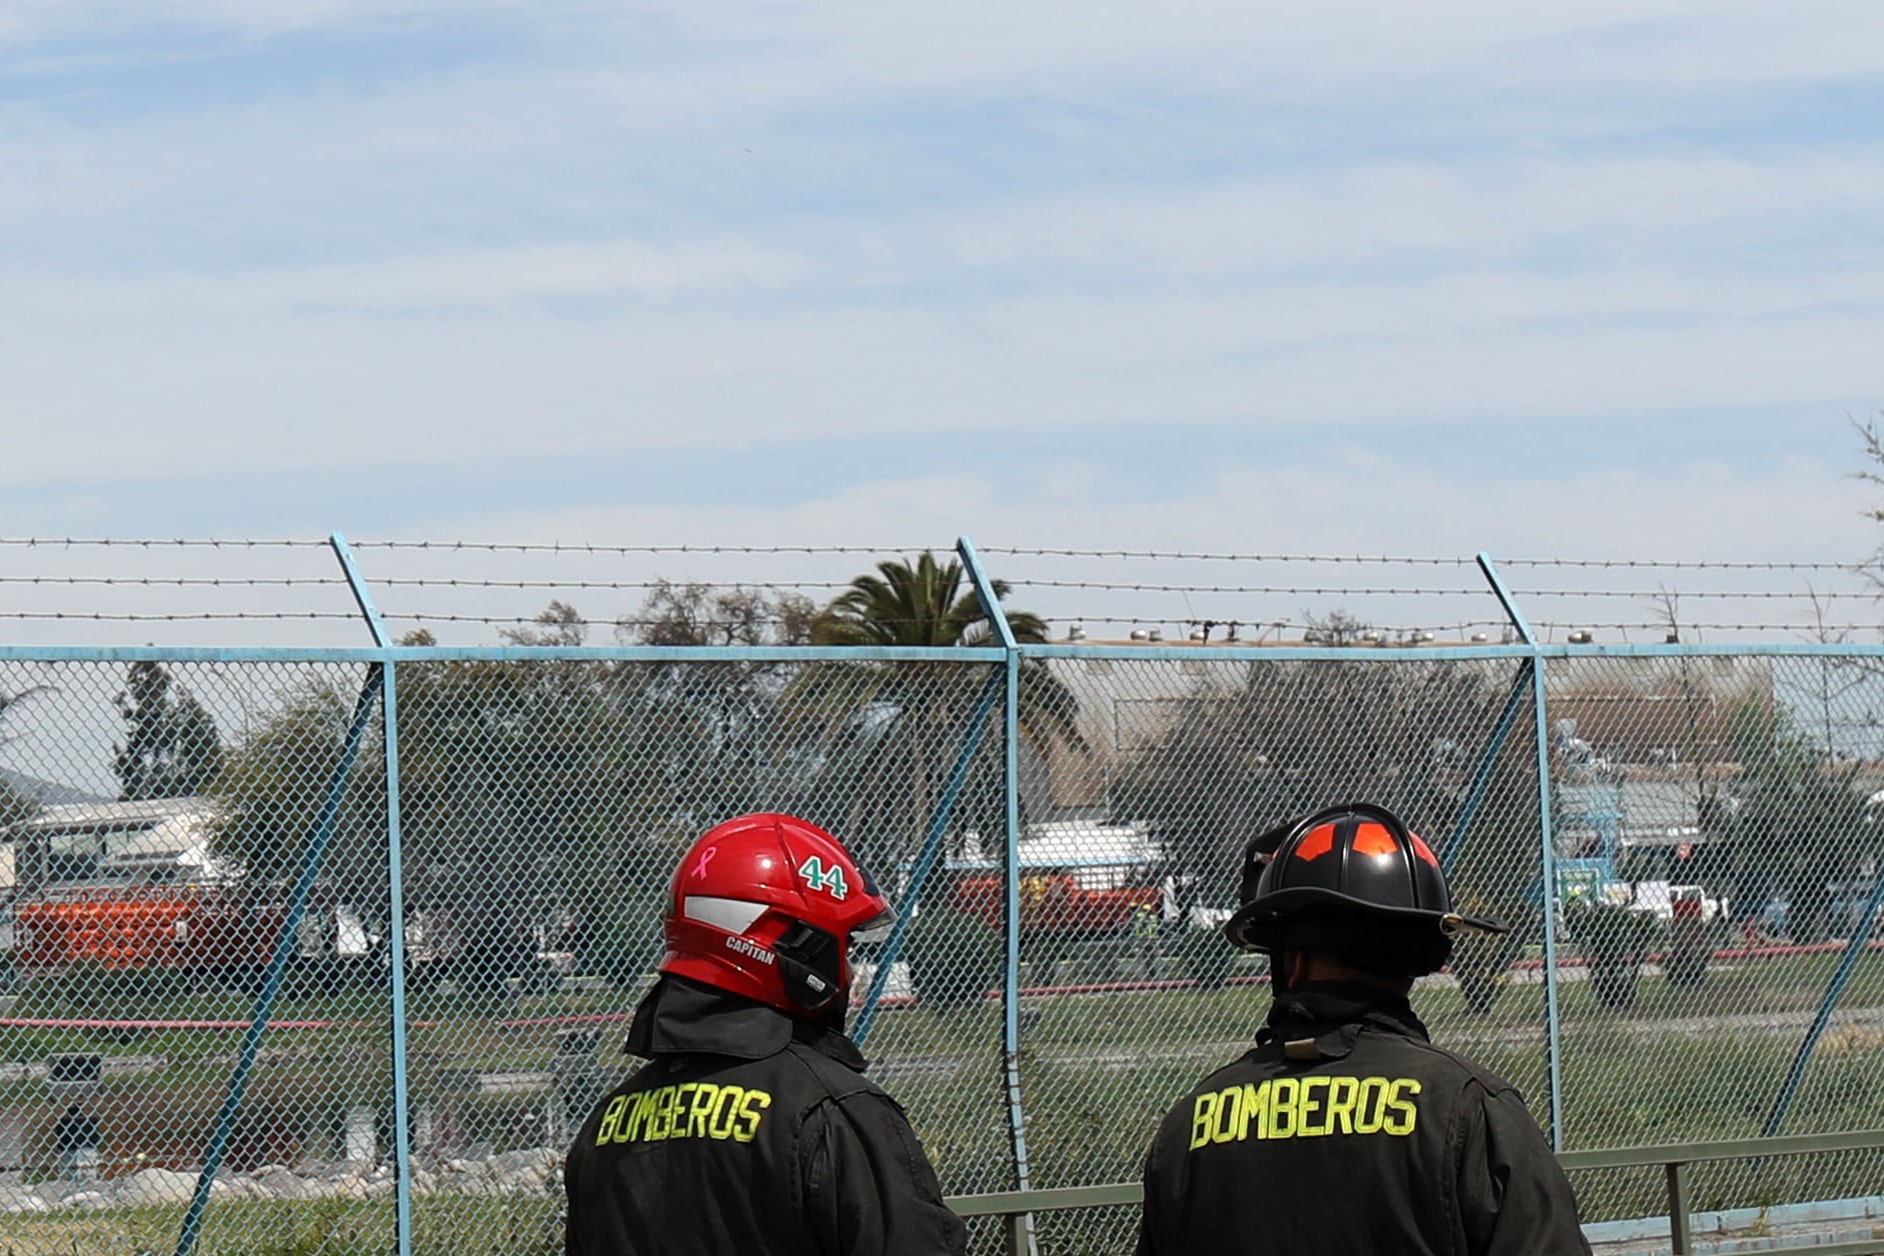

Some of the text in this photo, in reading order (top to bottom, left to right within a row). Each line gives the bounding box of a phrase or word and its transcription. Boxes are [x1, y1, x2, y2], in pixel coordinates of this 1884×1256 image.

[799, 856, 847, 900] 44
[725, 936, 775, 965] CAPITAN
[595, 1082, 772, 1146] BOMBEROS
[1189, 1076, 1422, 1152] BOMBEROS
